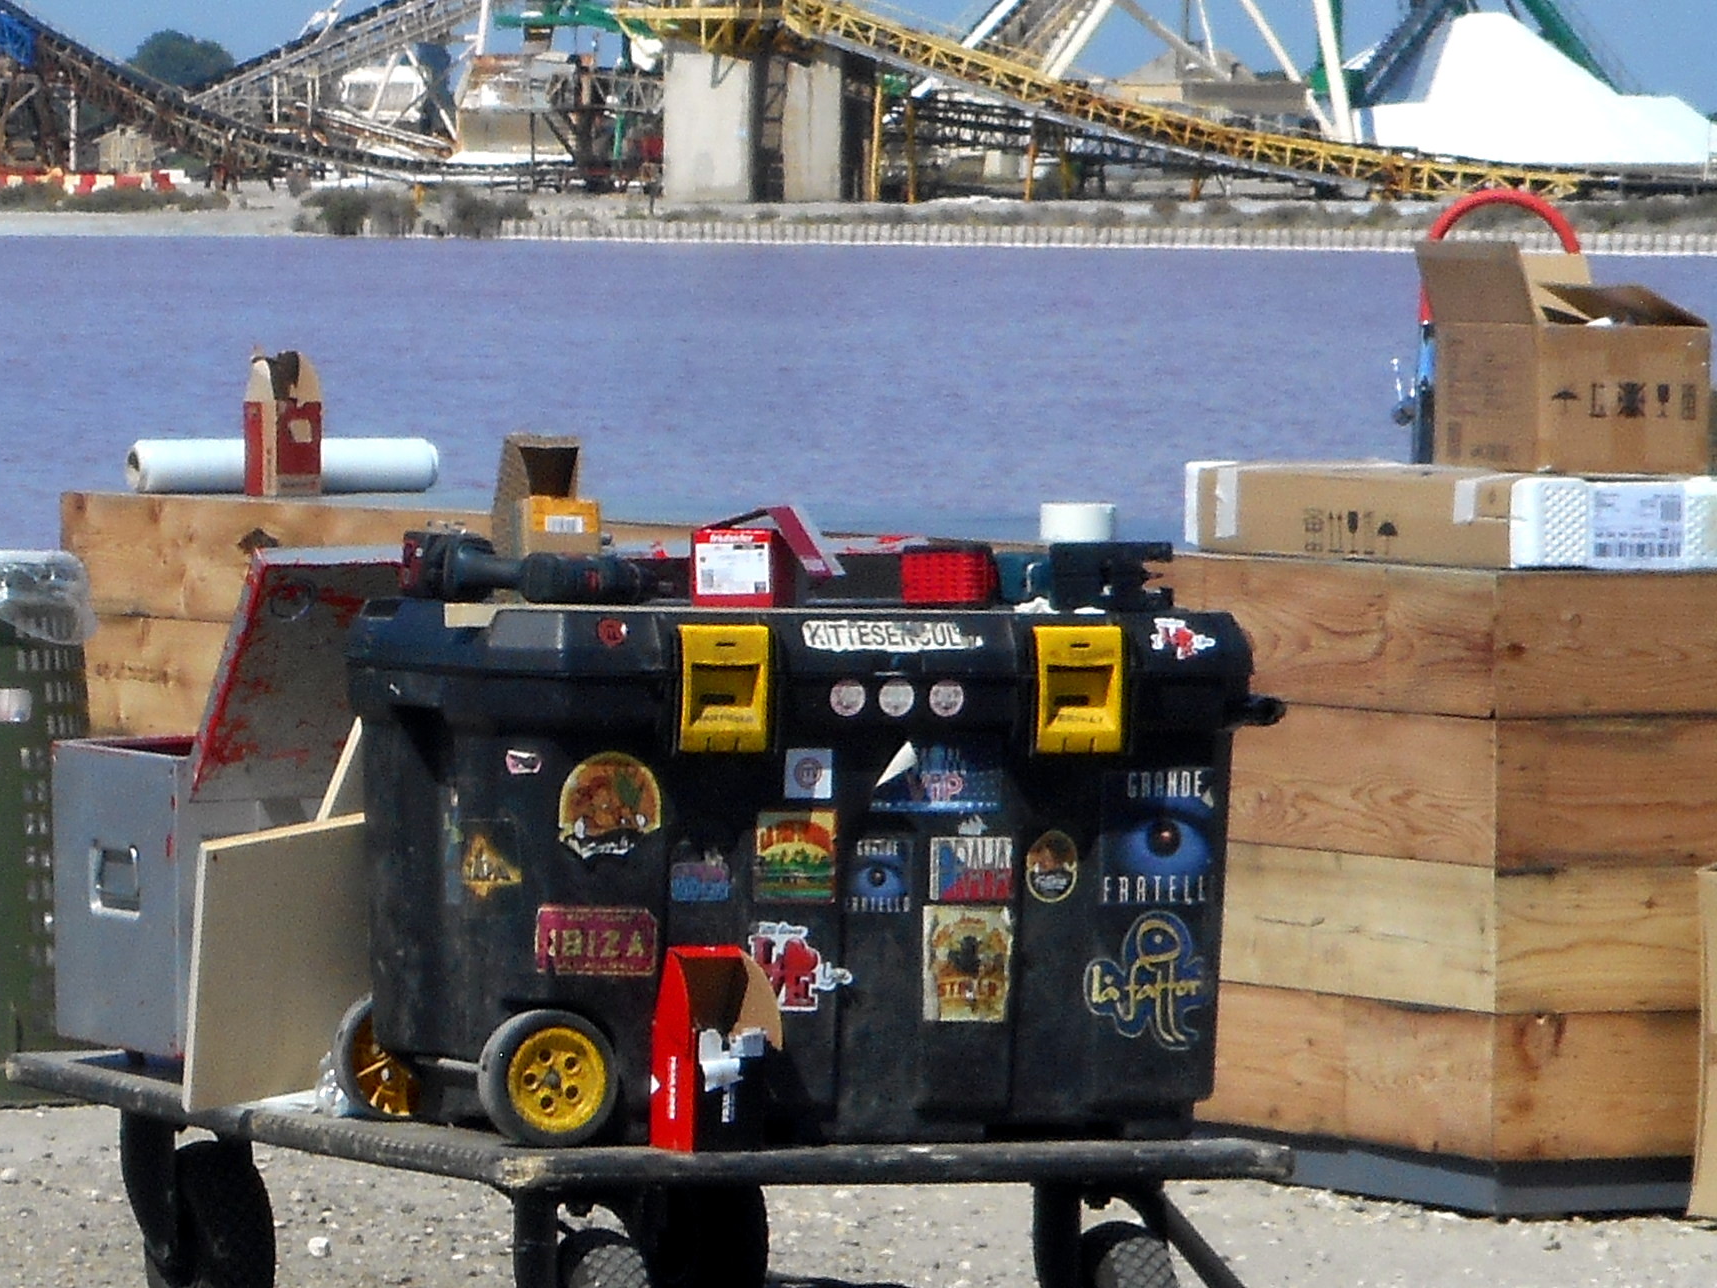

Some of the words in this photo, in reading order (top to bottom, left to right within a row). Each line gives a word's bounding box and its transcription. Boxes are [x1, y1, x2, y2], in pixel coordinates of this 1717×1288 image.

[1127, 770, 1203, 799] GRANDE
[846, 896, 911, 912] RATELLO
[1102, 875, 1207, 904] FRATELL
[548, 928, 645, 958] IBIZA
